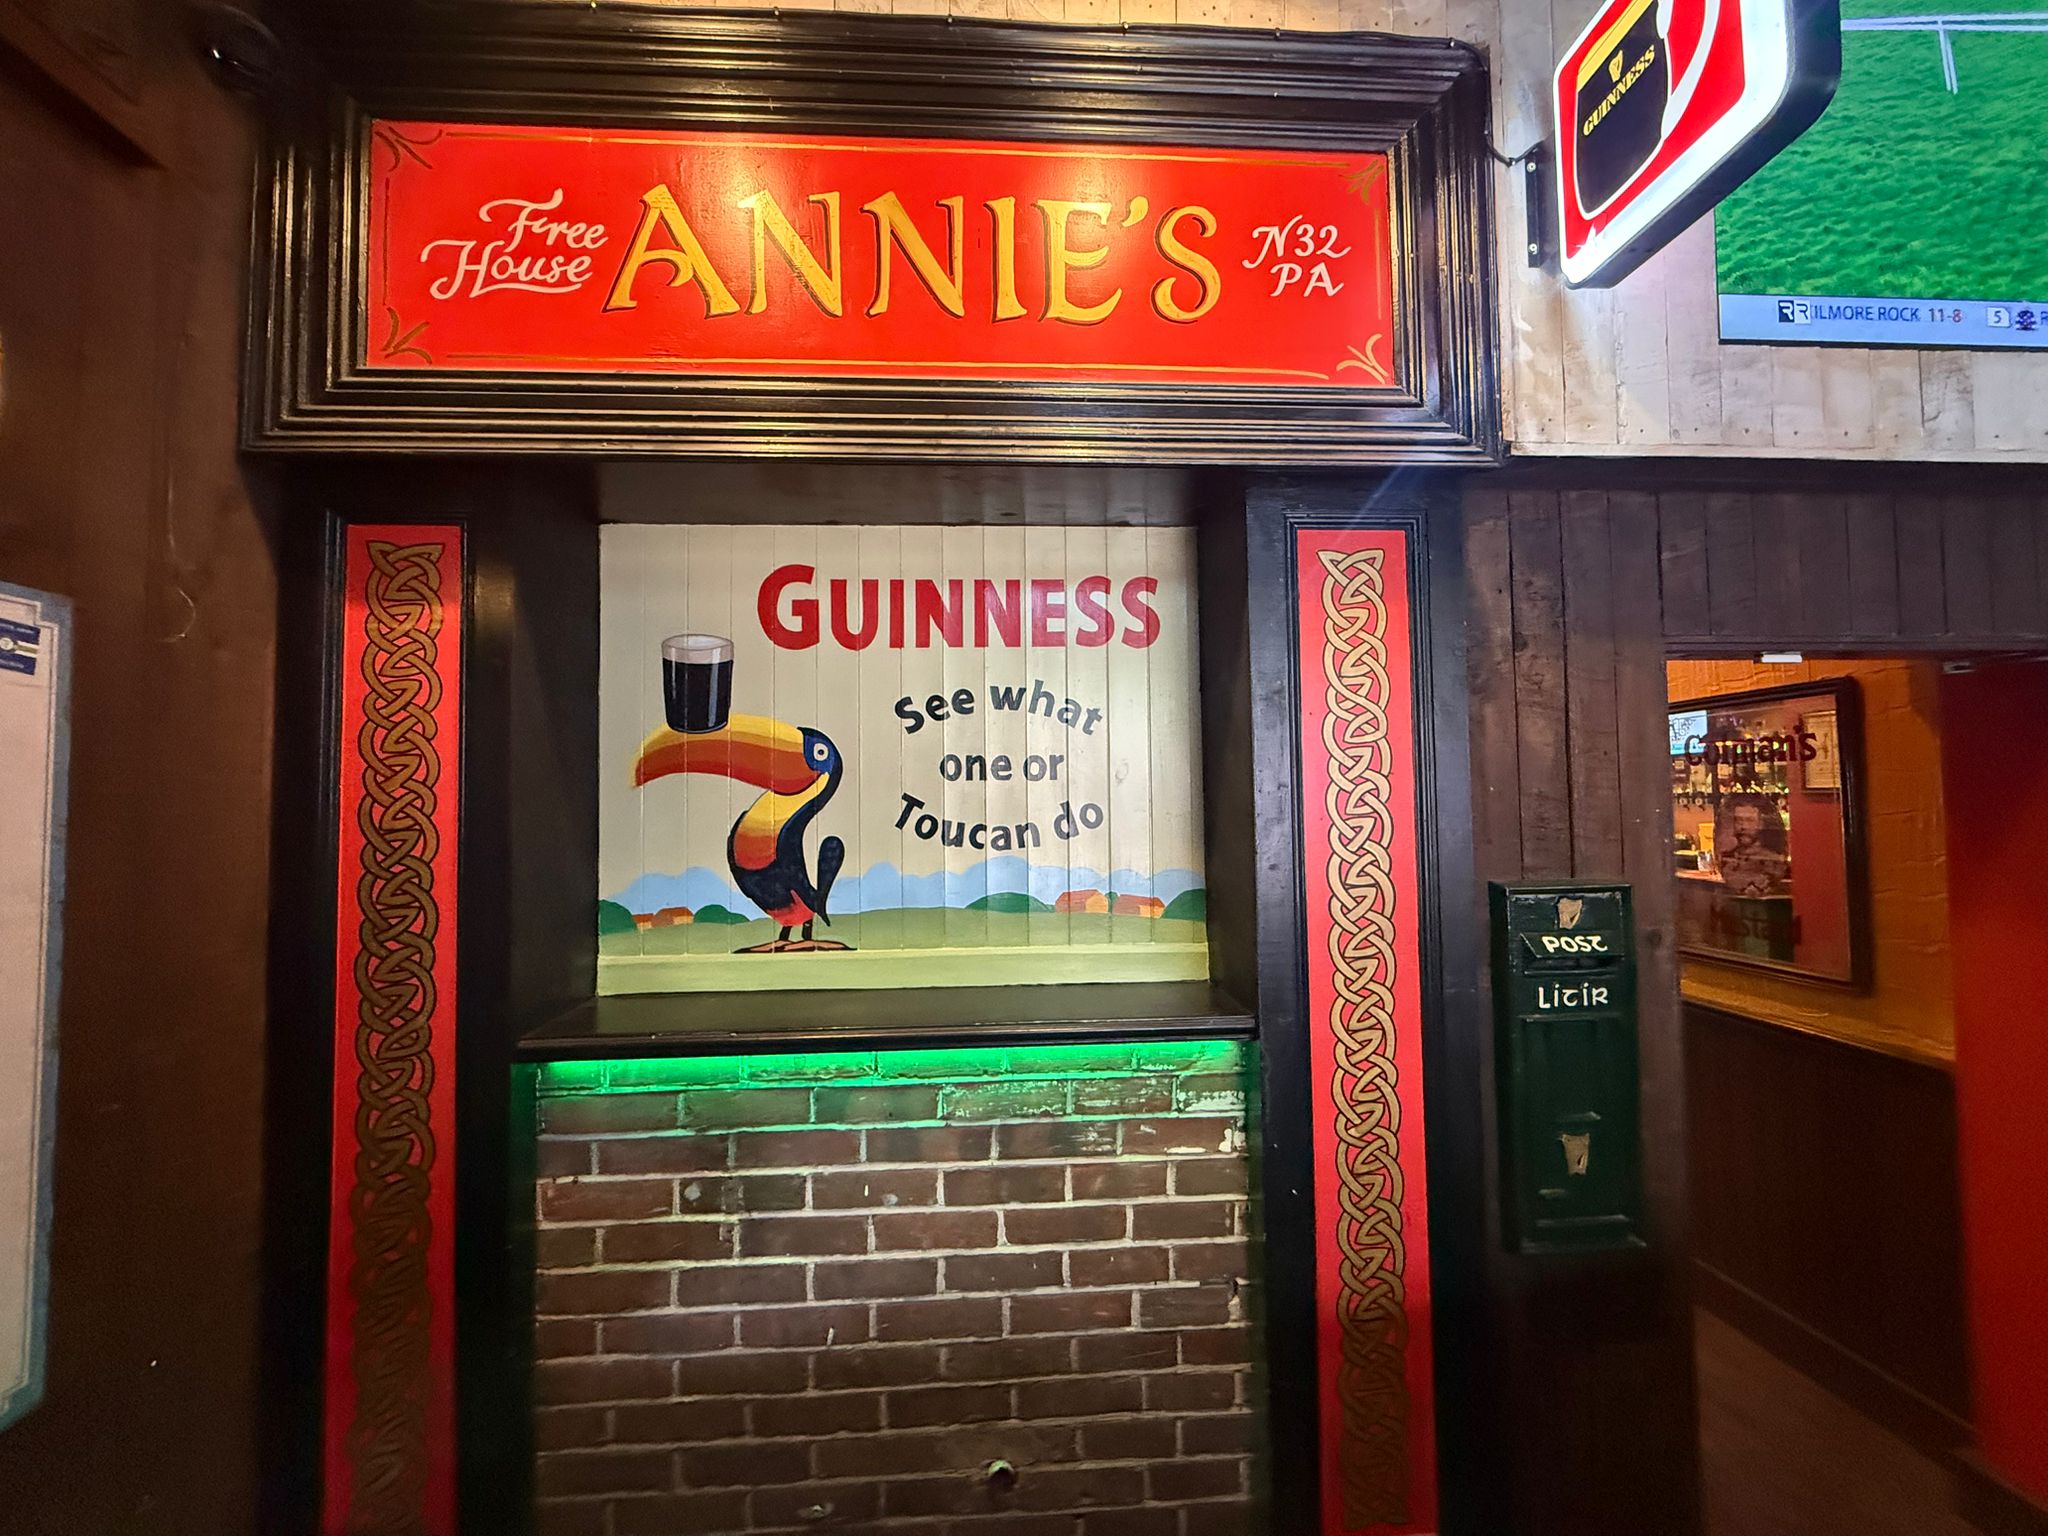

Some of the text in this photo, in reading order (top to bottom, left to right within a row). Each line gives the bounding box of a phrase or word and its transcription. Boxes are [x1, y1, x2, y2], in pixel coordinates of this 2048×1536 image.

[1583, 44, 1655, 136] GUINNESS
[479, 187, 609, 253] Free
[1241, 214, 1352, 269] N32
[420, 239, 593, 300] House
[602, 183, 1222, 326] ANNIE'S
[1270, 262, 1345, 297] PA
[1811, 304, 1962, 323] ILMORE ROCK 11-8
[757, 564, 1161, 651] GUINNESS
[894, 679, 1103, 735] See what
[939, 752, 1065, 781] one or
[894, 792, 1104, 852] Toucan do
[1541, 935, 1608, 953] POST
